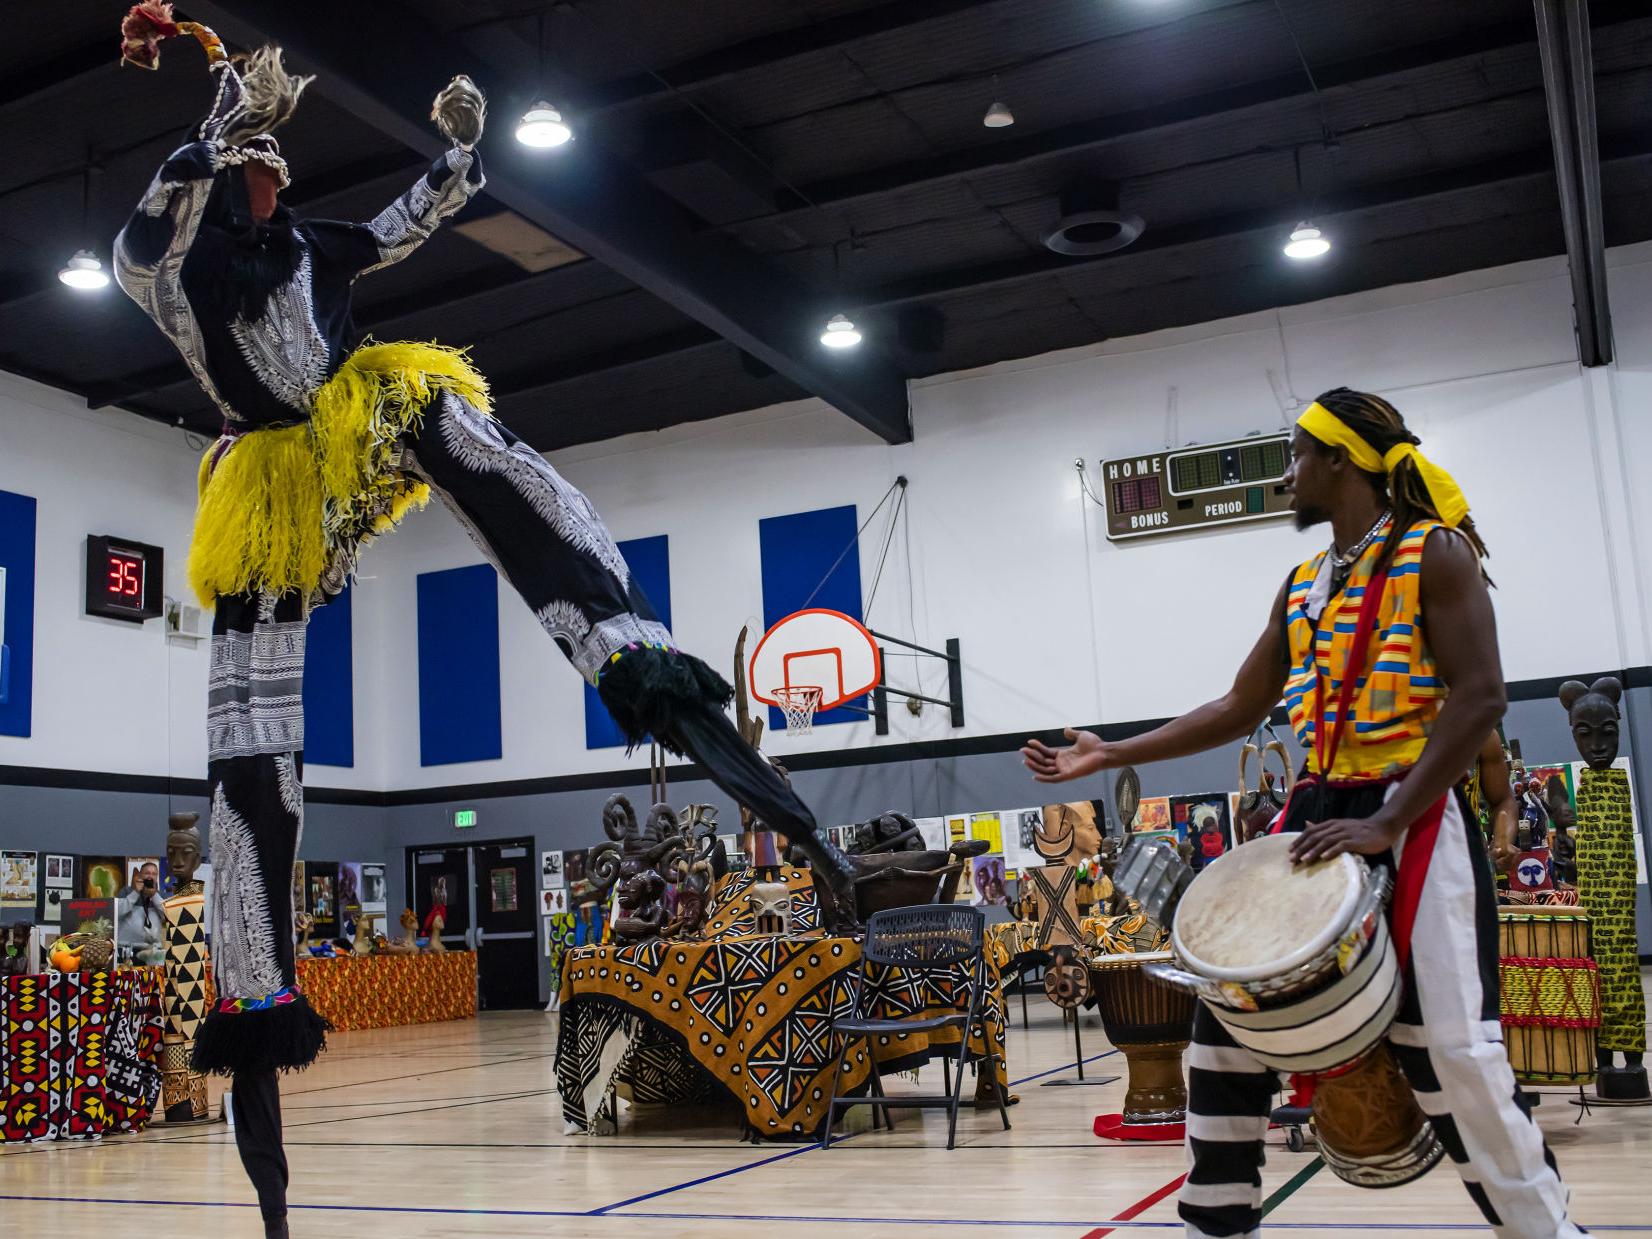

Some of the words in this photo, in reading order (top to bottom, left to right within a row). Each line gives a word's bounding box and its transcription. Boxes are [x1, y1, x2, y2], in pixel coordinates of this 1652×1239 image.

[1109, 458, 1161, 479] HOME
[1205, 501, 1242, 516] PERIOD
[1131, 511, 1169, 528] BONUS
[109, 559, 138, 595] 35
